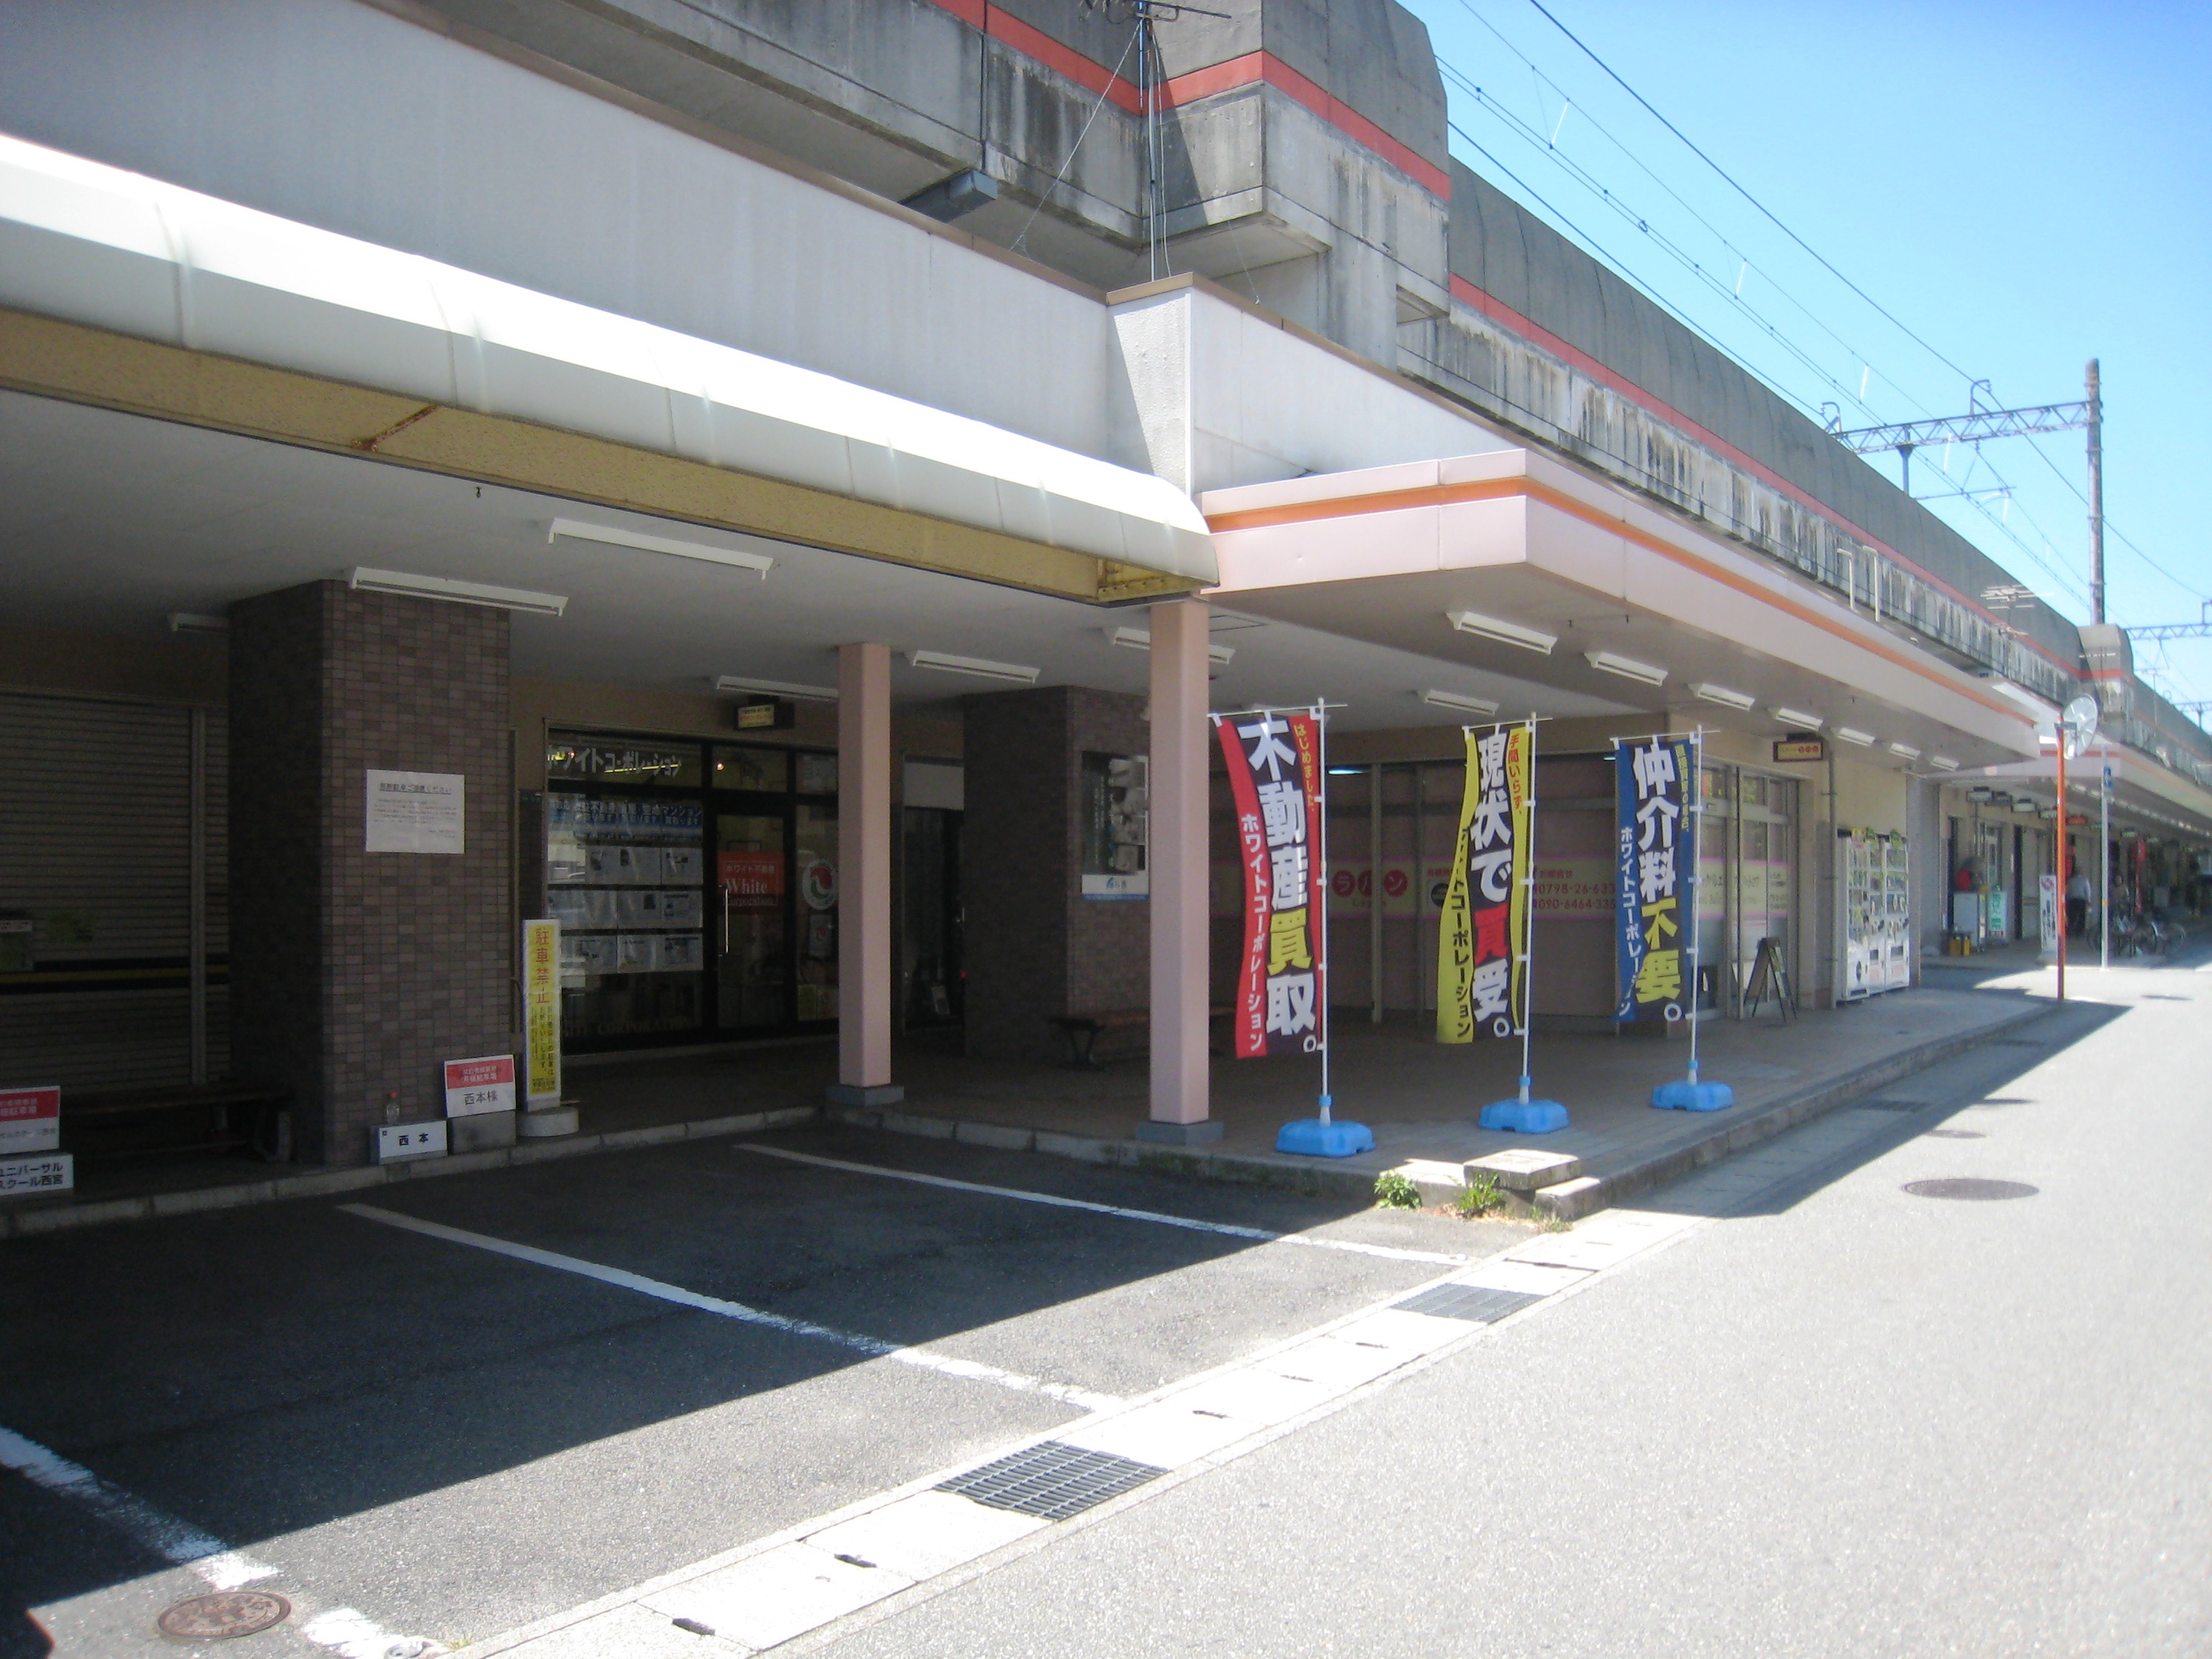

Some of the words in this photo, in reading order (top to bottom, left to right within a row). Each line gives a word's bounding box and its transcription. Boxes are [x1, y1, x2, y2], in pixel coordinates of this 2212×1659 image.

[536, 927, 550, 1004] 駐車禁止
[725, 878, 768, 894] White
[1237, 720, 1316, 1053] 不動産買取。
[1241, 814, 1267, 1051] ホワイトコーポレーション
[1451, 829, 1471, 1038] トコーポレーション
[1470, 733, 1512, 1038] 現状で買受。
[1619, 827, 1643, 1016] ホワイトコーポレーン
[1632, 745, 1682, 1022] 仲介料不要。
[464, 1090, 498, 1105] 西本様
